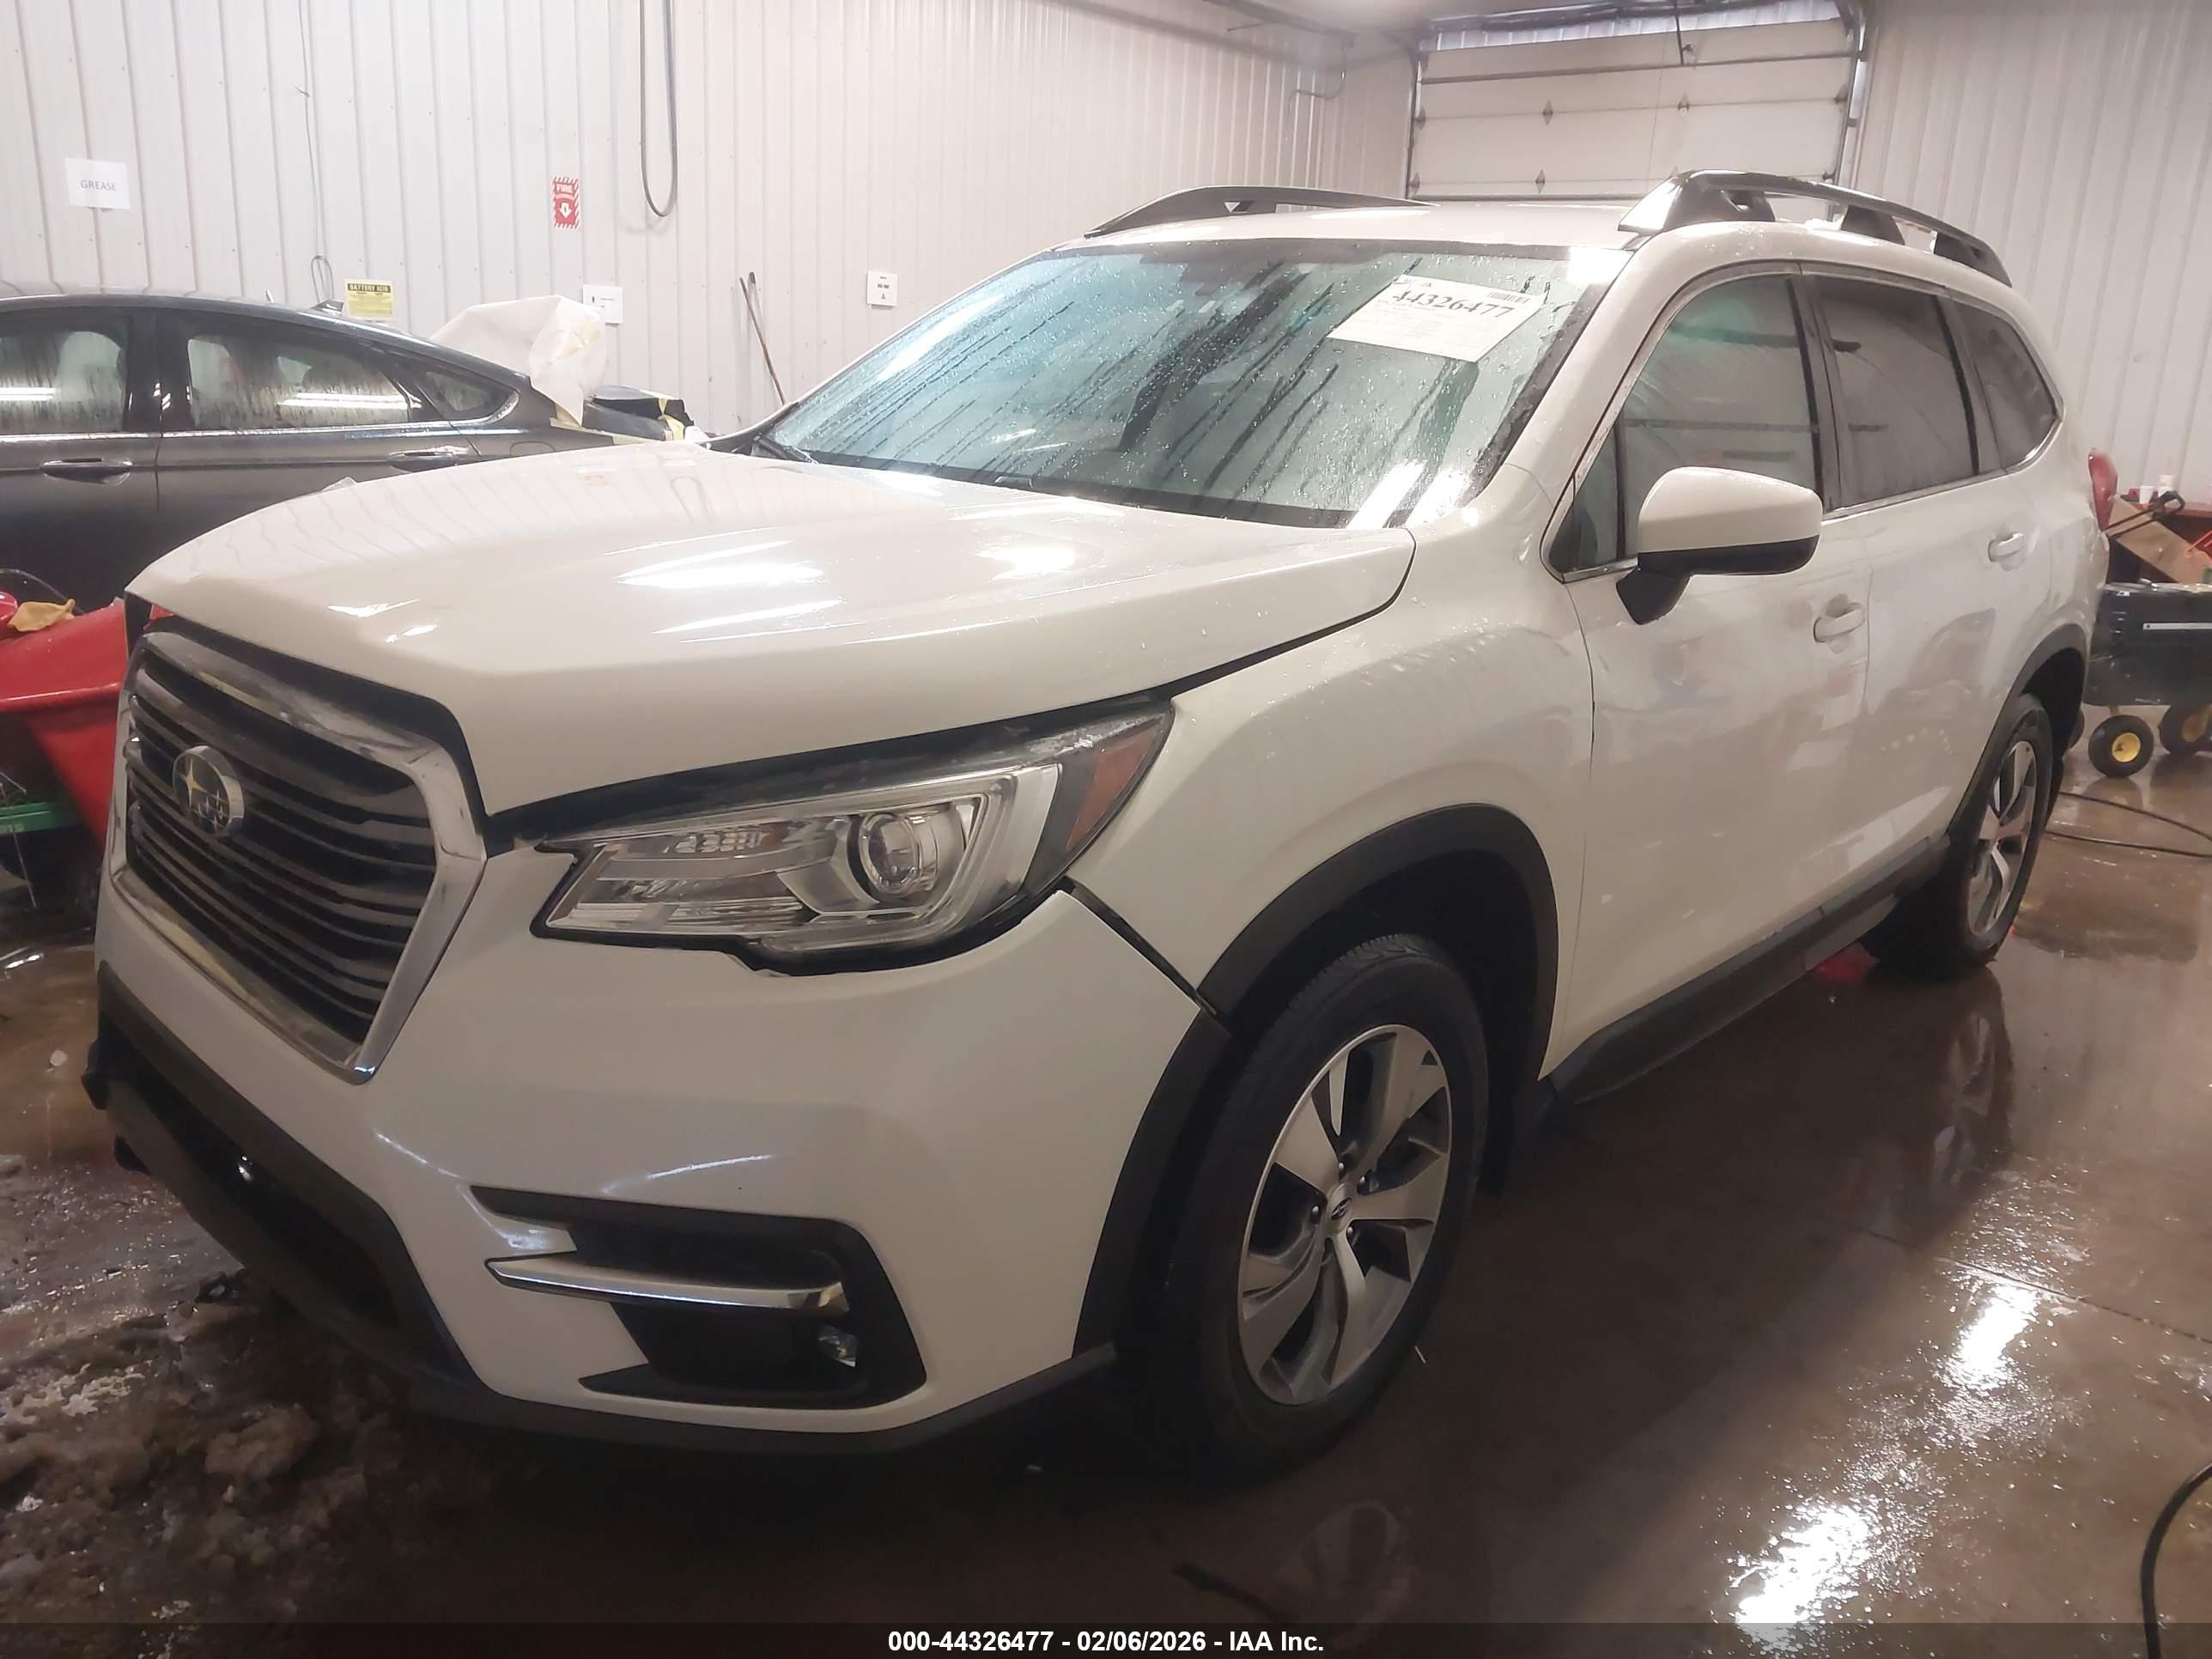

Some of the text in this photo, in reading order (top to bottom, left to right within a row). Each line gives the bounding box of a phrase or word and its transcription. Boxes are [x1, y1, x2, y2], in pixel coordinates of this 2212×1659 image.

[80, 179, 118, 191] GREASE
[556, 183, 574, 193] FIRE
[1392, 290, 1515, 318] 44326477
